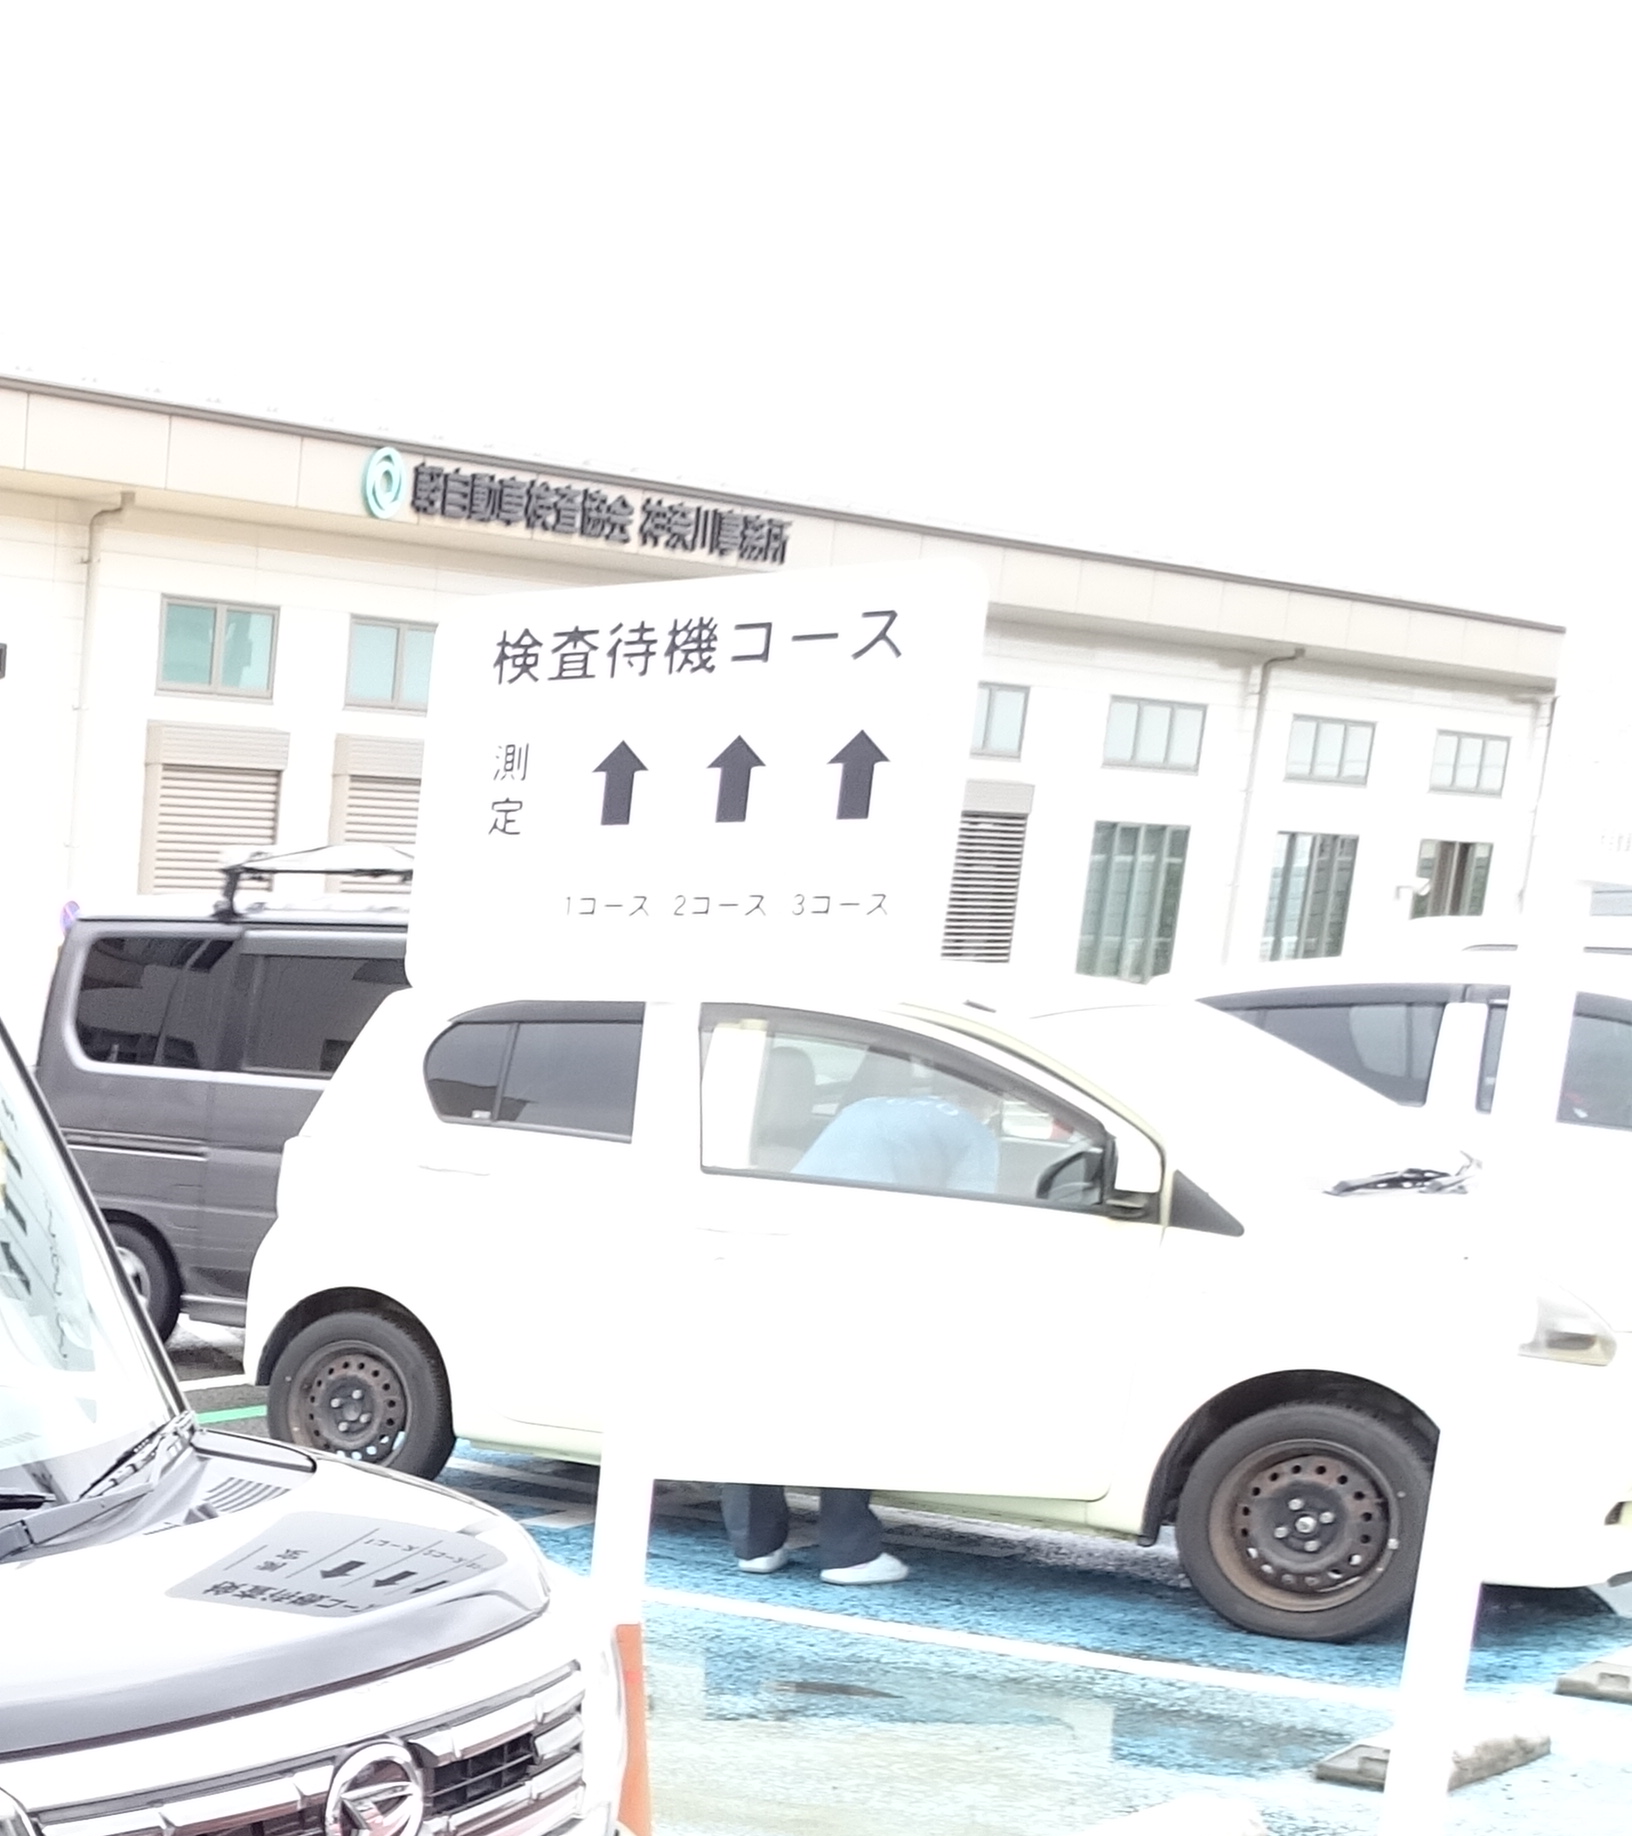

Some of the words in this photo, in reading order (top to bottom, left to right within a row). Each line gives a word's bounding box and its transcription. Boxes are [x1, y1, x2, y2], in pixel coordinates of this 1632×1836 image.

[412, 462, 635, 544] 軽自動車検査協会
[639, 497, 792, 564] 神奈川事務所
[493, 609, 903, 685] 検査待機コース
[487, 742, 530, 836] 測定
[566, 895, 649, 917] 1コース
[673, 894, 766, 917] 2コース
[792, 893, 888, 917] 3コース
